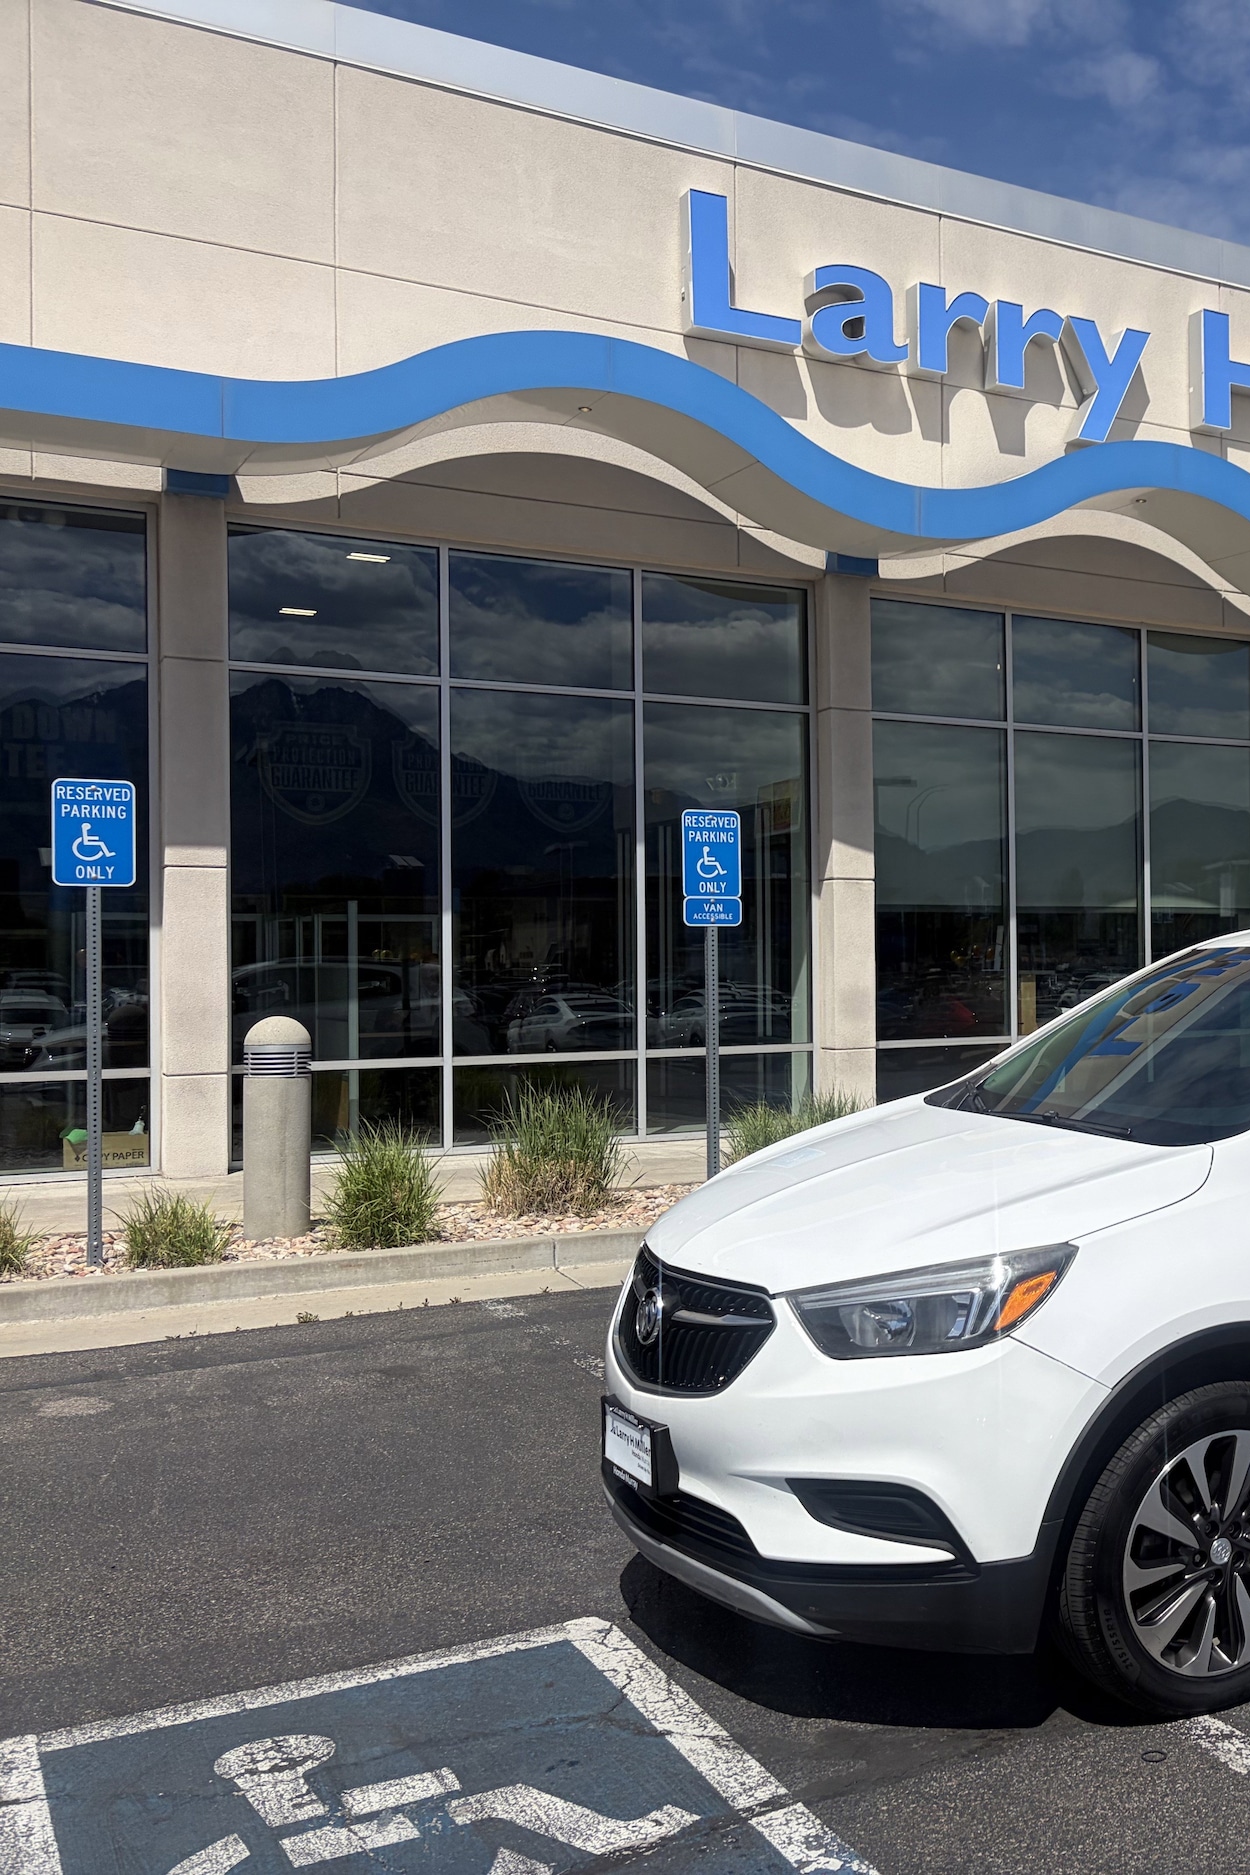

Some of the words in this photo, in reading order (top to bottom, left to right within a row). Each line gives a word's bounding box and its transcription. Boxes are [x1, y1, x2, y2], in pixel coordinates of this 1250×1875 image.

[687, 188, 1151, 444] Larry
[285, 734, 346, 746] PRICE
[273, 745, 356, 765] PROTECTION
[272, 766, 358, 791] GUARANTEE
[56, 786, 131, 802] RESERVED
[61, 804, 127, 819] PARKING
[685, 816, 737, 829] RESERVED
[688, 831, 735, 843] PARKING
[75, 865, 115, 880] ONLY
[699, 881, 727, 893] ONLY
[703, 903, 724, 912] VAN
[82, 1152, 110, 1162] CY
[112, 1150, 144, 1161] PAPER
[616, 1425, 630, 1446] Larry
[635, 1437, 651, 1457] Miller
[1103, 1608, 1134, 1670] 215/55R18
